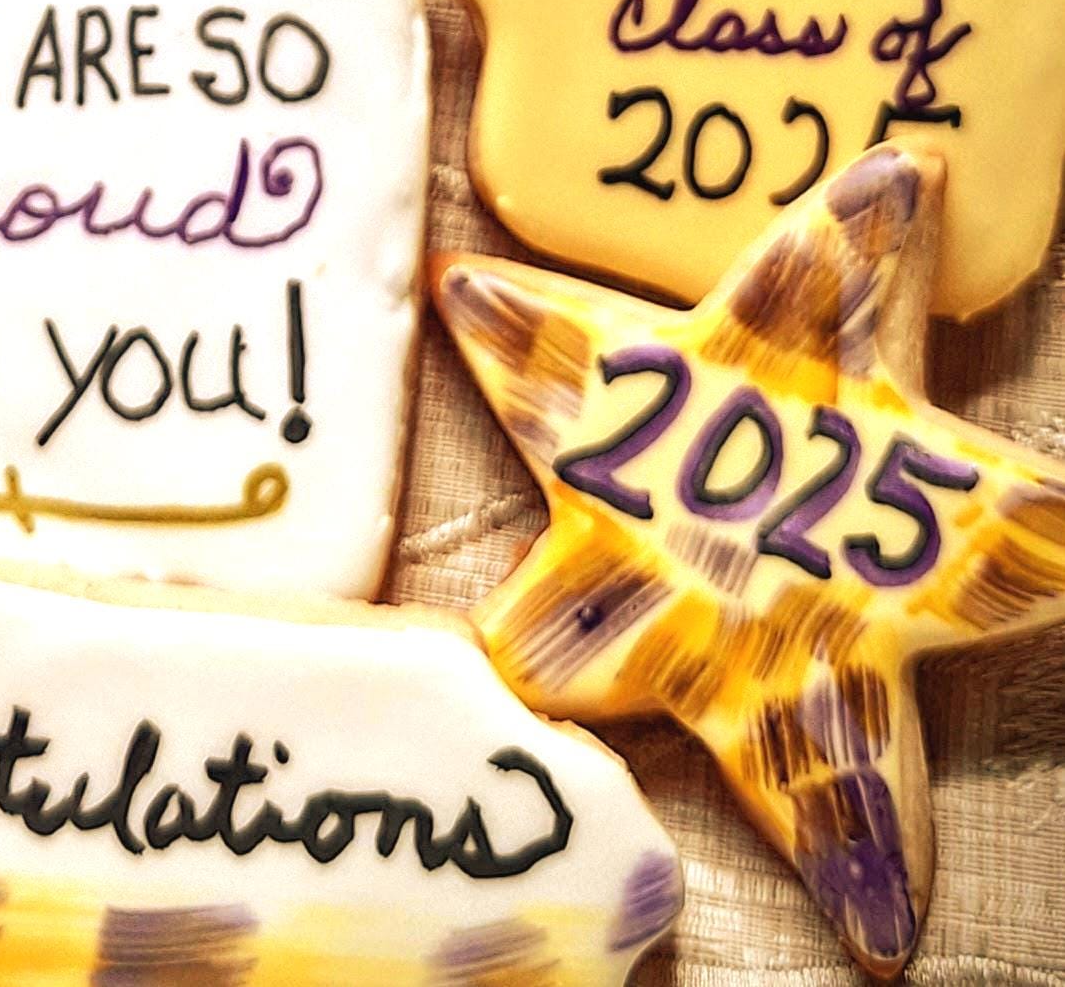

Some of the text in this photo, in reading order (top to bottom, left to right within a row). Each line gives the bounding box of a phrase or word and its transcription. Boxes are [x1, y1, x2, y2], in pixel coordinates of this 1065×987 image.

[15, 6, 170, 109] ARE
[190, 10, 330, 106] SO
[551, 344, 980, 588] 2025
